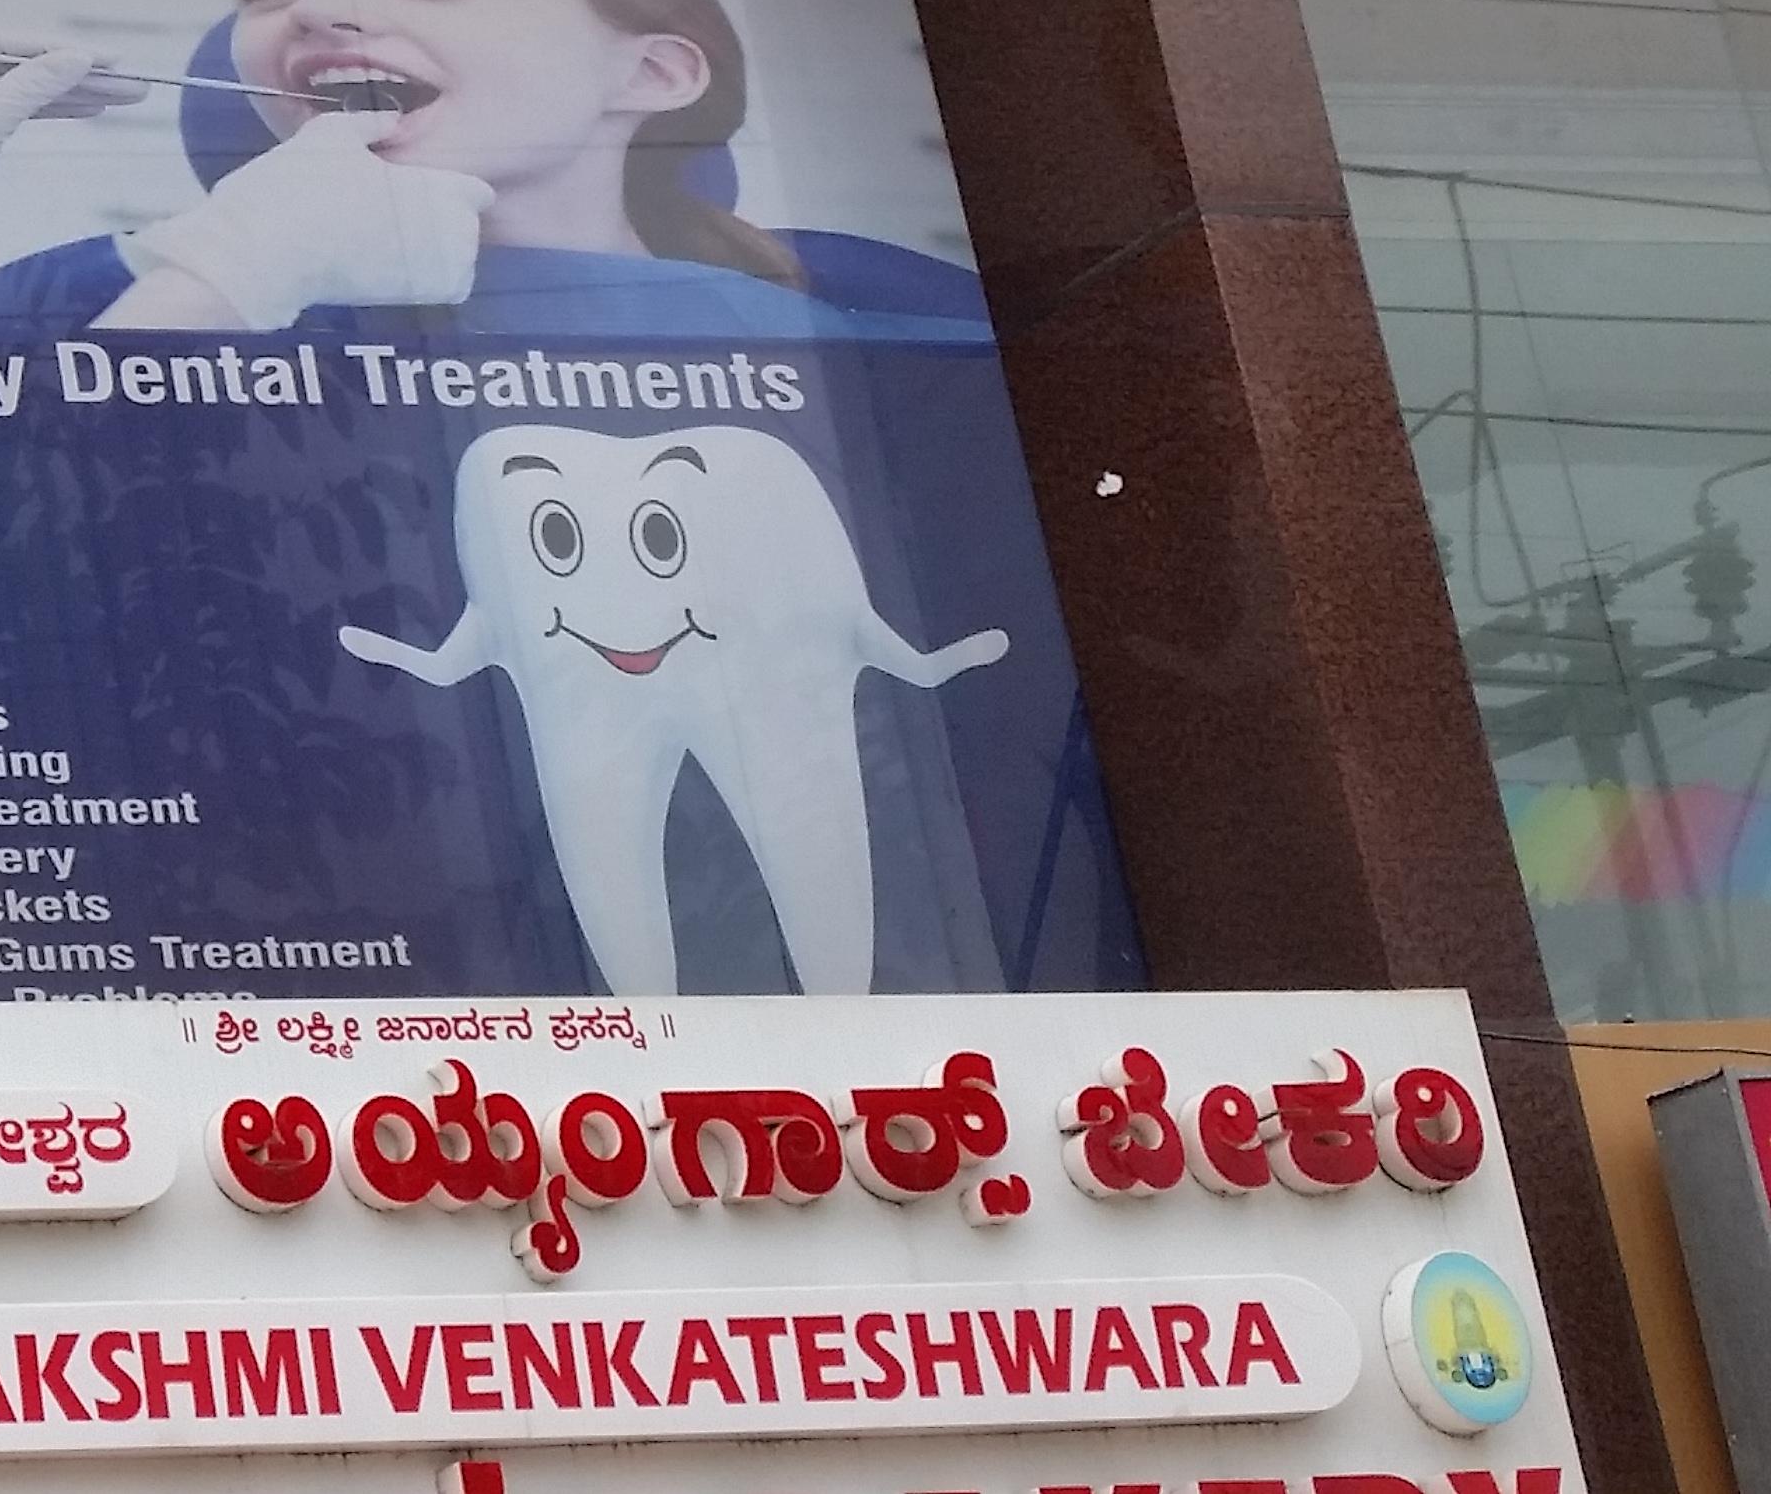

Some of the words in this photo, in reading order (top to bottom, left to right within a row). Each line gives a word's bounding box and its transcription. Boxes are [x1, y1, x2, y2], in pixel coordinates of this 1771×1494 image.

[57, 340, 323, 406] Dental
[345, 344, 804, 412] Treatments
[149, 933, 412, 970] Treatment
[215, 1011, 259, 1054] ಶ್ರೀ
[1061, 1048, 1485, 1196] ಬೇಕರಿ
[358, 1300, 1301, 1416] VENKATESHWARA
